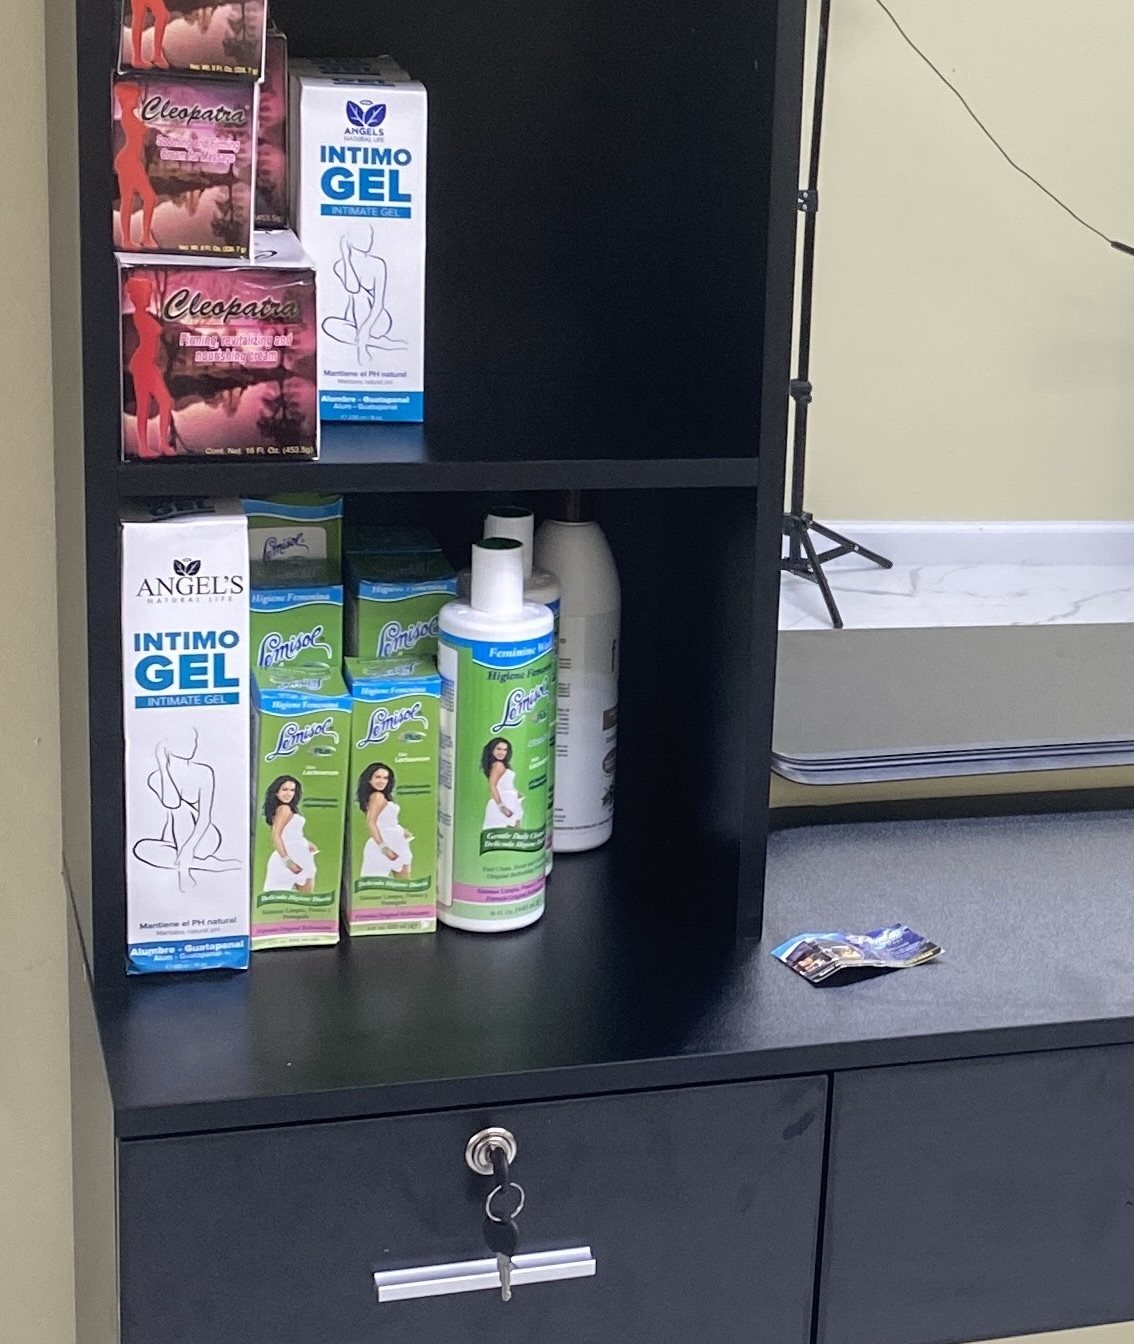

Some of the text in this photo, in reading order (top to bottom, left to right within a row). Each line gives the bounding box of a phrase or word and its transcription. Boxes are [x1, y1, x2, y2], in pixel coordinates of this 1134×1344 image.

[141, 96, 245, 126] Cleopatra
[344, 127, 385, 137] ANGELS
[320, 145, 413, 167] INTIMO
[320, 166, 412, 203] GEL
[331, 206, 400, 217] INTIMATE GEL
[164, 289, 299, 324] Cleopatra
[179, 333, 294, 348] Firming, revitalizing and
[194, 350, 279, 364] nourishing cream
[323, 369, 407, 379] Mantiene el PH natural
[320, 395, 357, 404] Alumbre
[136, 575, 244, 597] ANGEL'S
[147, 595, 233, 604] NATURAL LIFE
[133, 629, 240, 652] INTIMO
[257, 625, 333, 668] Lemisol
[488, 646, 536, 659] Feminine
[134, 652, 240, 692] GEL
[486, 670, 525, 684] Higiene
[147, 694, 228, 707] INTIMATE GEL
[356, 701, 429, 749] Lemisol
[264, 716, 340, 763] Lemisol
[139, 916, 237, 930] Mantiene el PH natural
[130, 939, 245, 957] Alumbre Guatapanal
